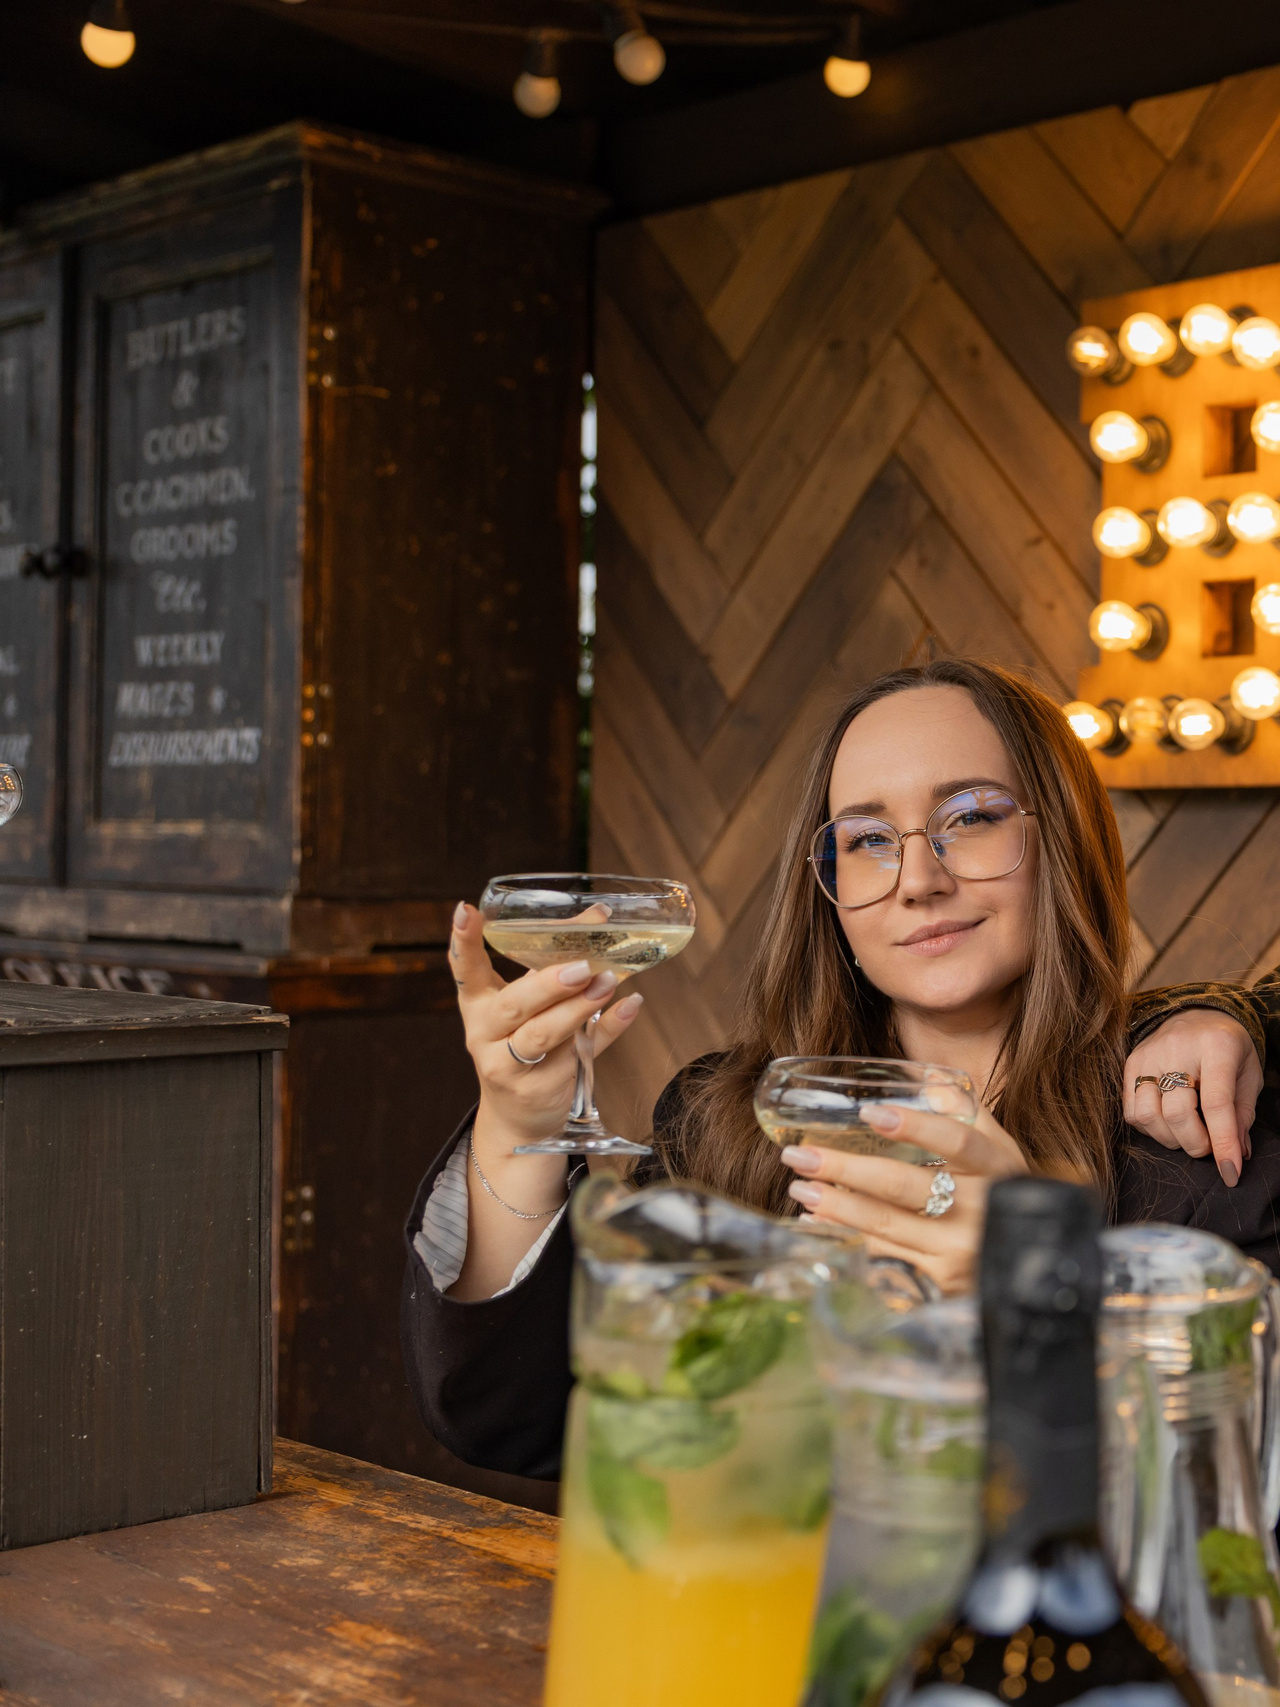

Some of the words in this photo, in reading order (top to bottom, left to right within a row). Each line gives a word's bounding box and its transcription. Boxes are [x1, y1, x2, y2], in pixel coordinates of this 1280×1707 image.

[126, 306, 245, 370] BUTLERS
[142, 415, 229, 465] COOKS
[130, 518, 238, 565] GROOMS
[133, 631, 225, 667] WEEKLY
[115, 682, 194, 718] WAGES
[108, 727, 262, 767] DISBURSEMENTS
